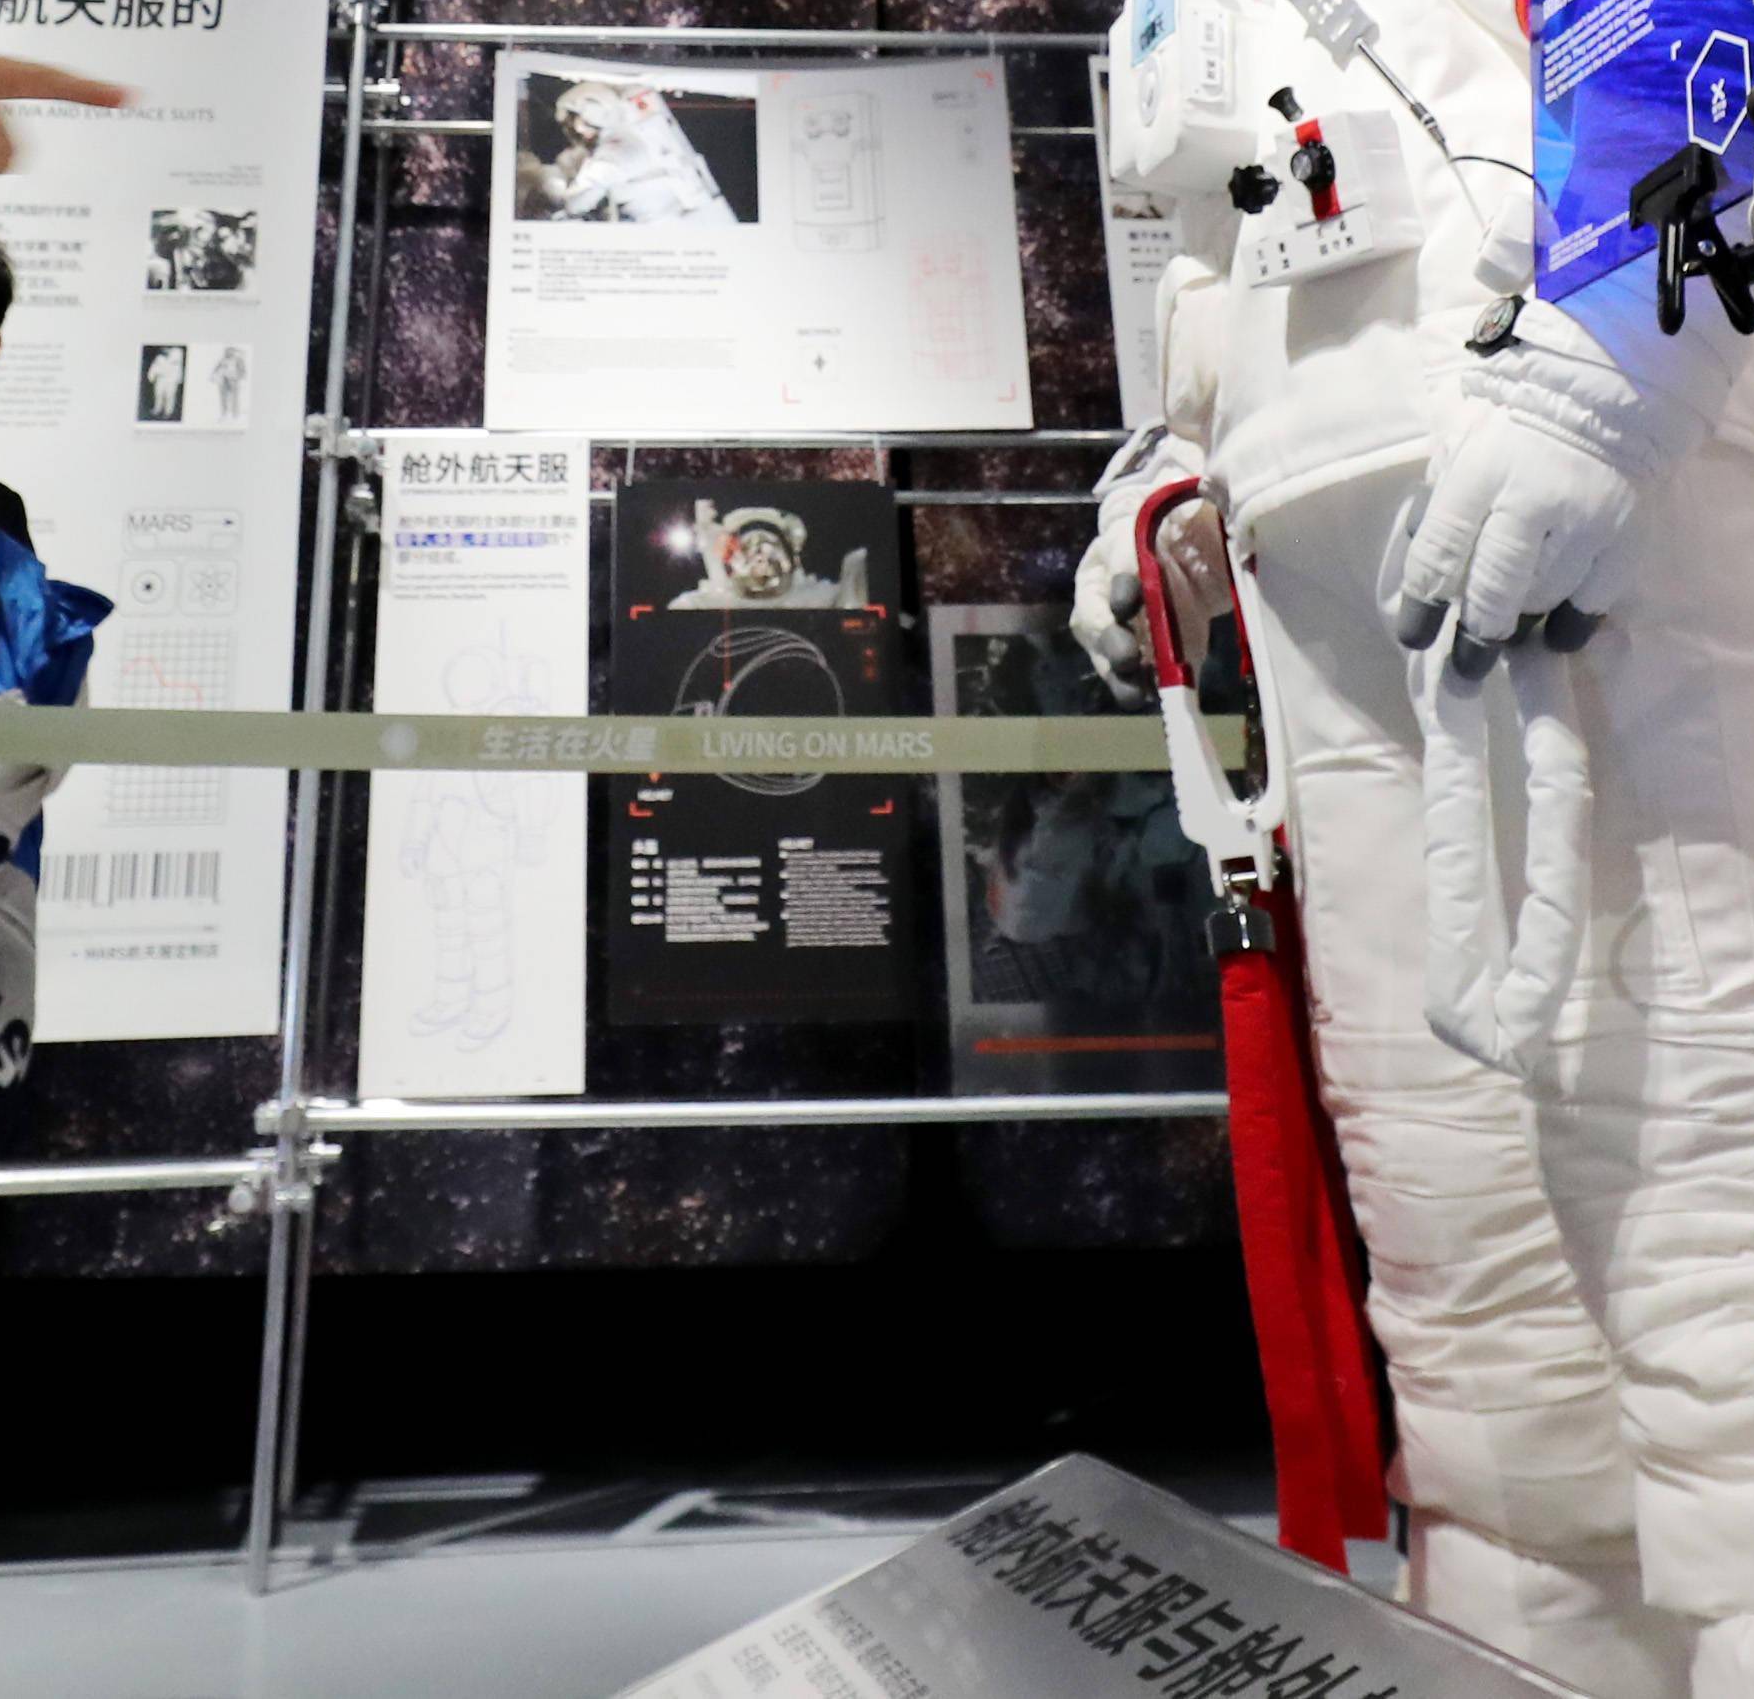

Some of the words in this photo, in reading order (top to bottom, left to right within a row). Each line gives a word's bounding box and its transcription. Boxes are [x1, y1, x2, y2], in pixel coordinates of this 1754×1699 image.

[400, 452, 569, 484] 舱外航天服
[128, 513, 193, 532] MARS
[478, 725, 658, 762] 生活在火星
[701, 731, 798, 758] LIVING
[803, 732, 846, 758] ON
[856, 732, 934, 760] MARS
[946, 1496, 1398, 1699] 舱内航天服与舱外
